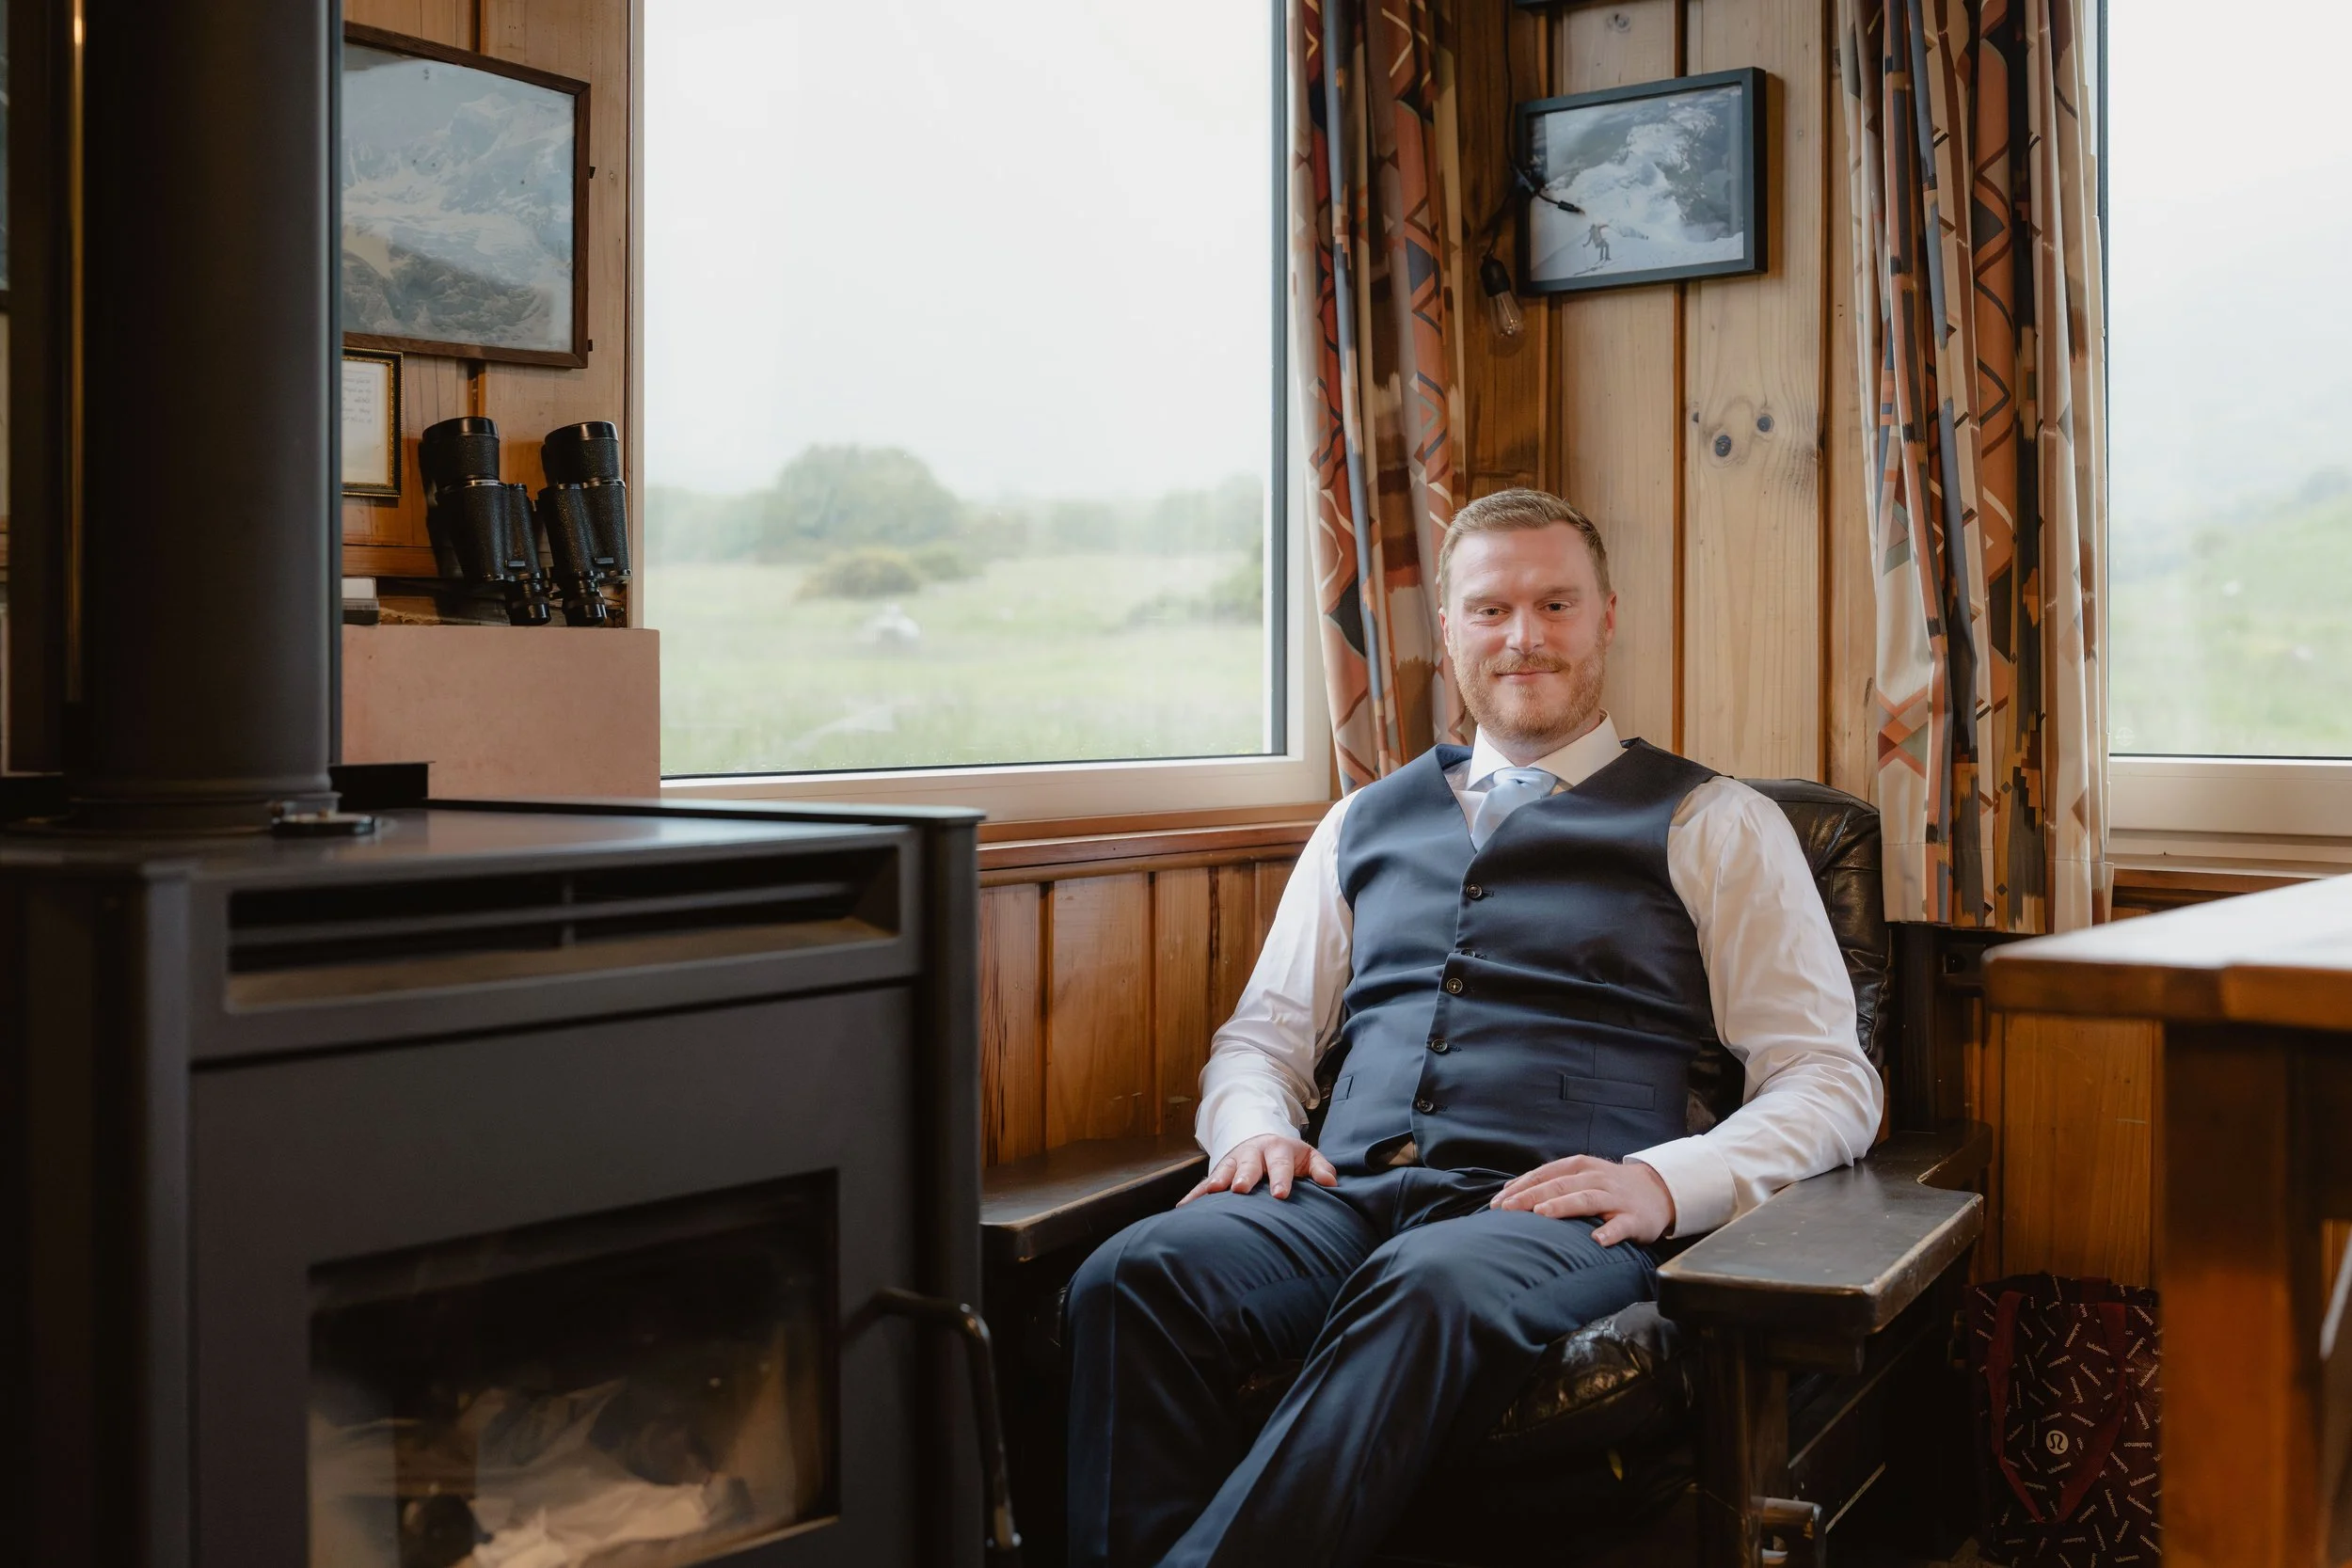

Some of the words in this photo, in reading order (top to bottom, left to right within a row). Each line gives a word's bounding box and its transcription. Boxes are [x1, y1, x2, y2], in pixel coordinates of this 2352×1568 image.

[2064, 1323, 2082, 1347] lululemon
[2126, 1338, 2146, 1359] lululemon
[2079, 1363, 2101, 1386] lululemon
[2138, 1364, 2159, 1386] lululemon
[2135, 1402, 2150, 1430] lululemon
[2130, 1473, 2156, 1486] lululemon
[2105, 1489, 2118, 1517] lululemon
[2127, 1495, 2152, 1514] lululemon
